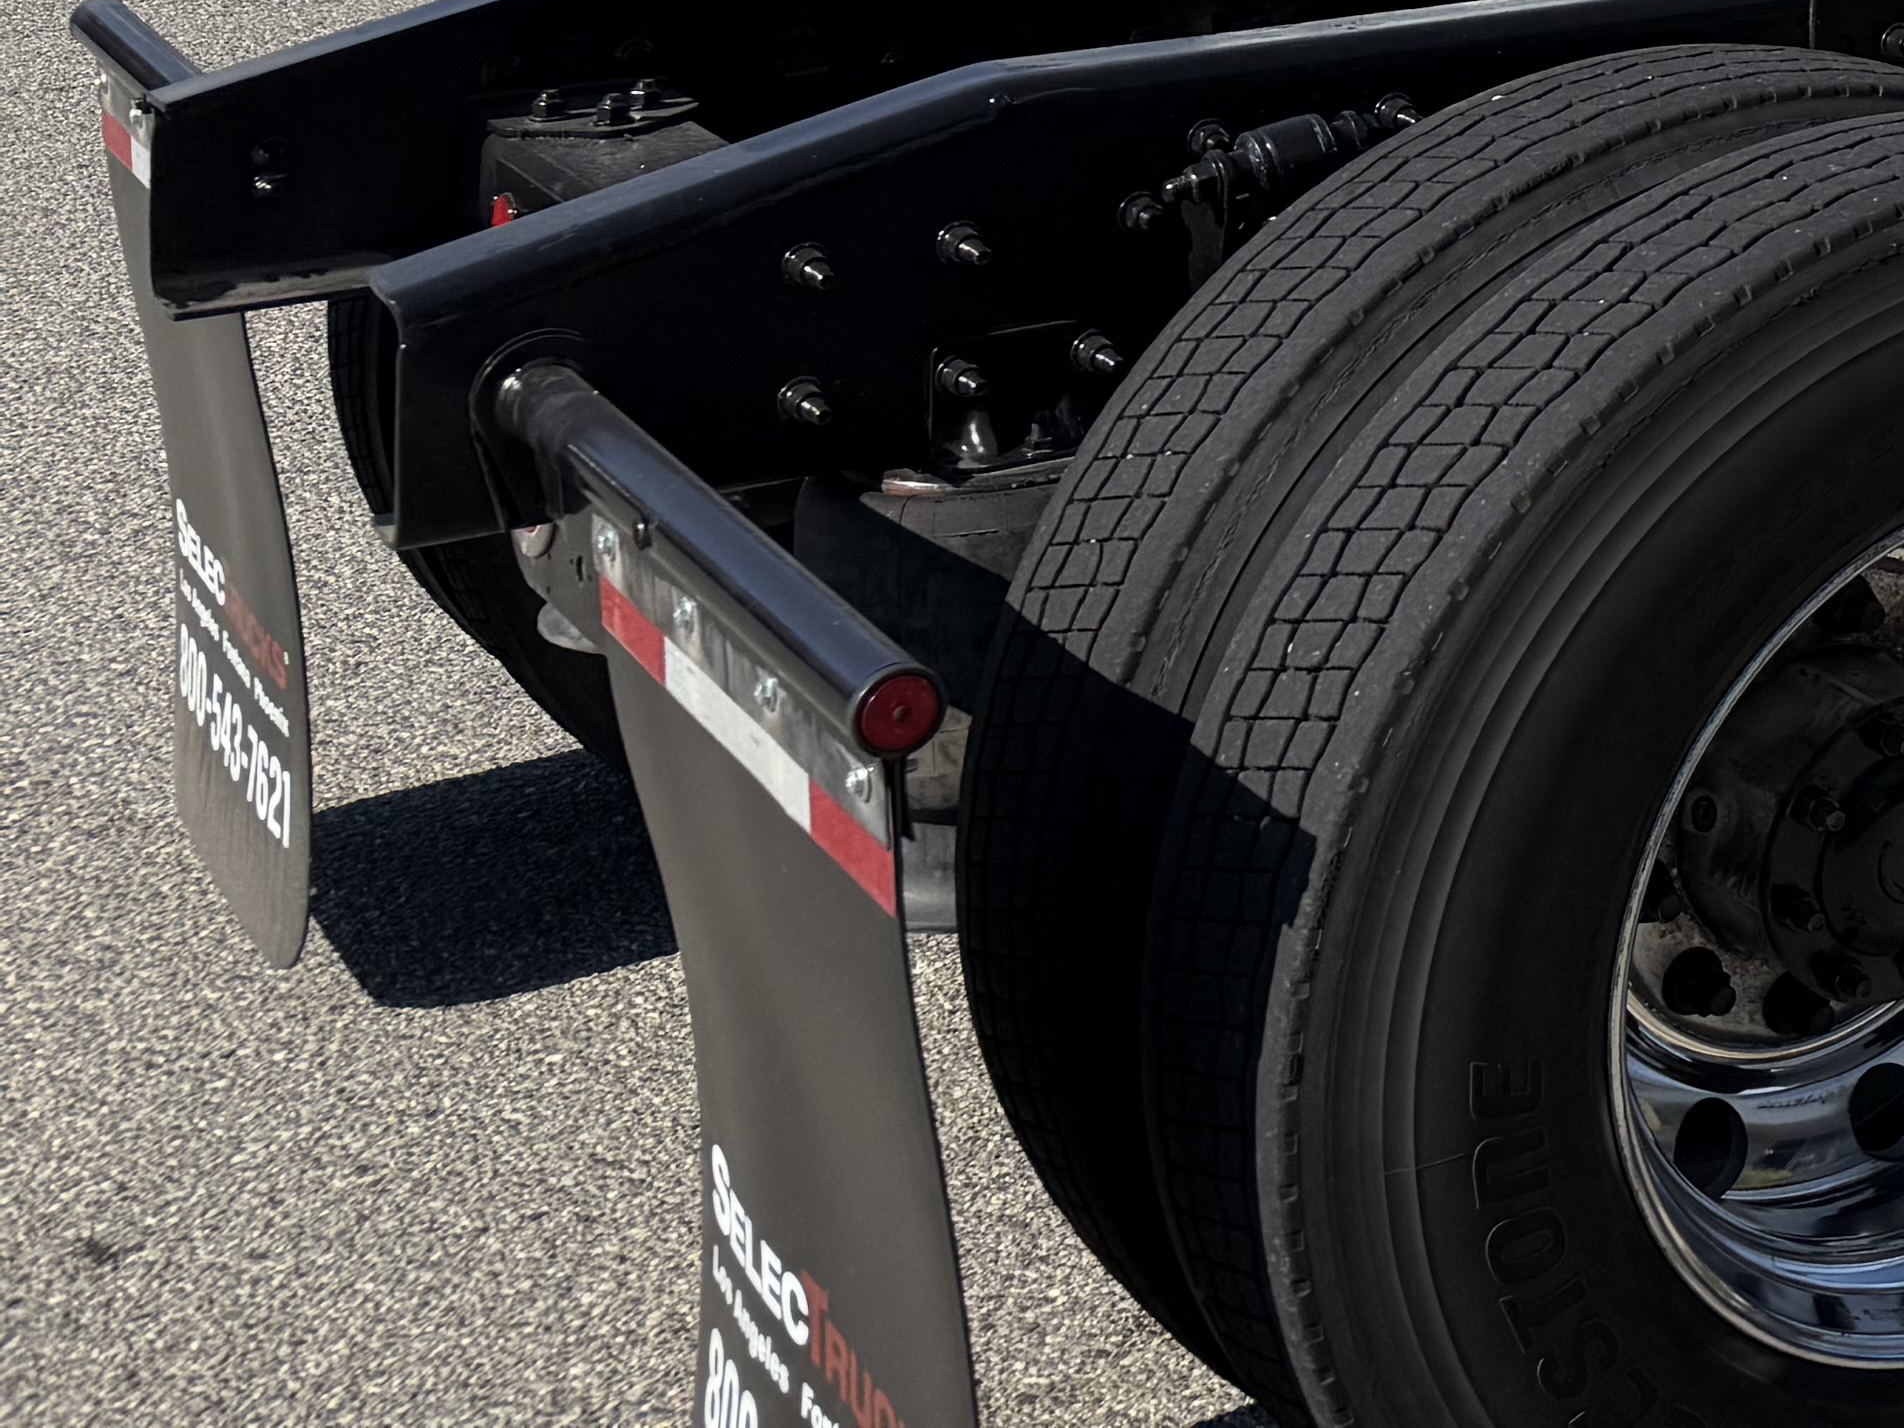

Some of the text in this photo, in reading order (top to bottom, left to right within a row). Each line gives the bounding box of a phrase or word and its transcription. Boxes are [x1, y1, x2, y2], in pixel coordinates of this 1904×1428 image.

[179, 623, 290, 848] 800-543-7621
[713, 1244, 733, 1305] Los
[733, 1289, 789, 1394] Angeles
